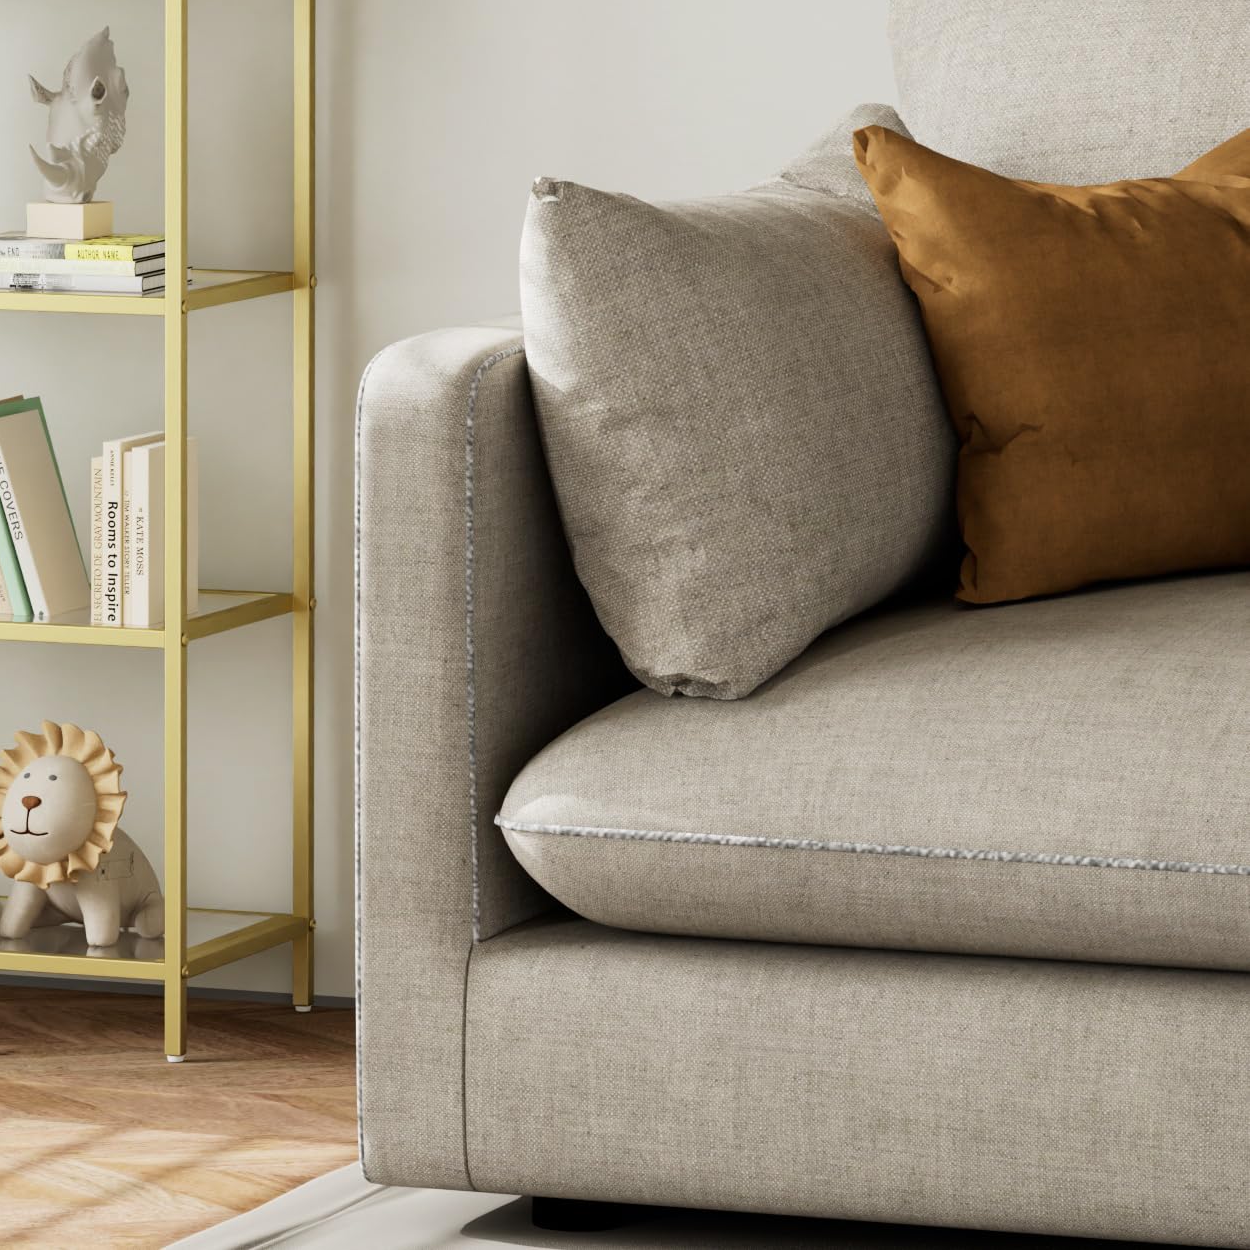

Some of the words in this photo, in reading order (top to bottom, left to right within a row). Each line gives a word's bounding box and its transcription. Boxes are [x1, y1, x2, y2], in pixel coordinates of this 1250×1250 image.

[0, 480, 24, 540] COVERS
[93, 467, 103, 522] MOUNTAIN
[93, 522, 102, 549] GRAY
[107, 501, 119, 549] Rooms
[136, 516, 144, 544] KATE
[107, 553, 117, 568] to
[136, 547, 144, 576] MOSS
[93, 567, 102, 610] SECRETO
[105, 573, 119, 622] Inspire
